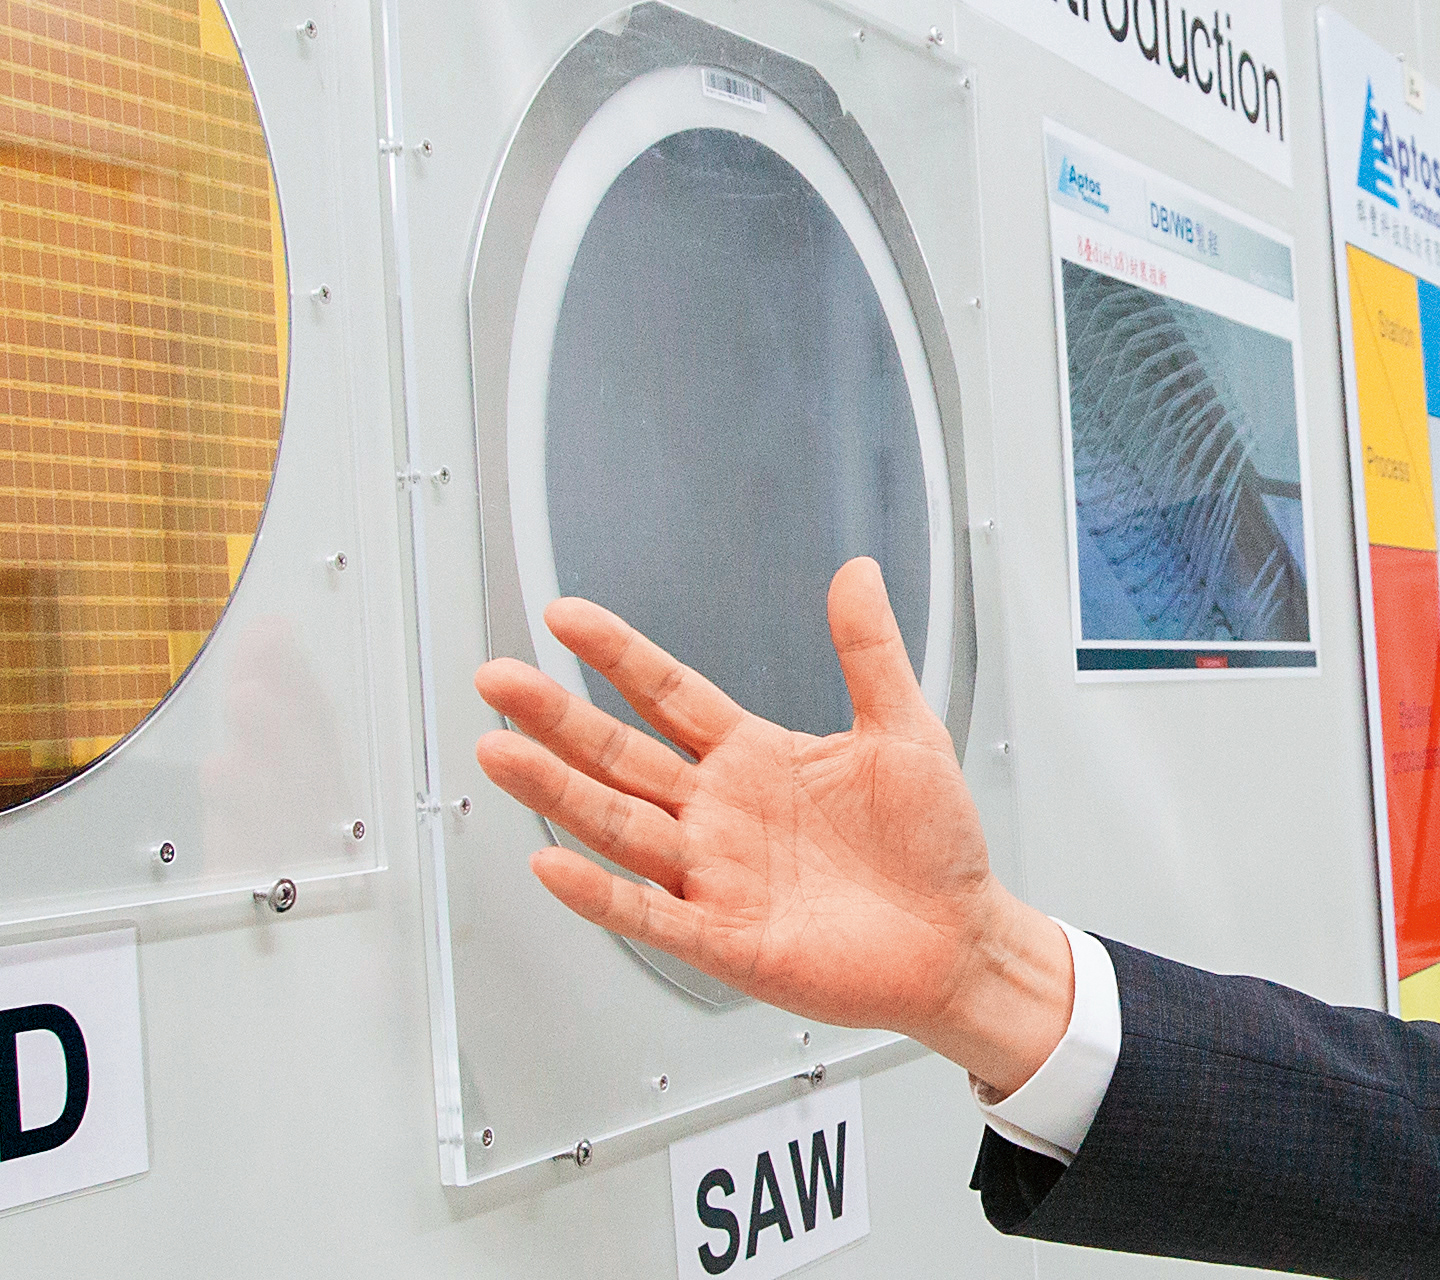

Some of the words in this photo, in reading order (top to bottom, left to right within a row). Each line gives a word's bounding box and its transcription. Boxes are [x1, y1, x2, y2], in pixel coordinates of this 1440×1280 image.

[1069, 165, 1102, 196] Aptos
[1366, 445, 1411, 484] Process
[696, 1121, 847, 1275] SAW
